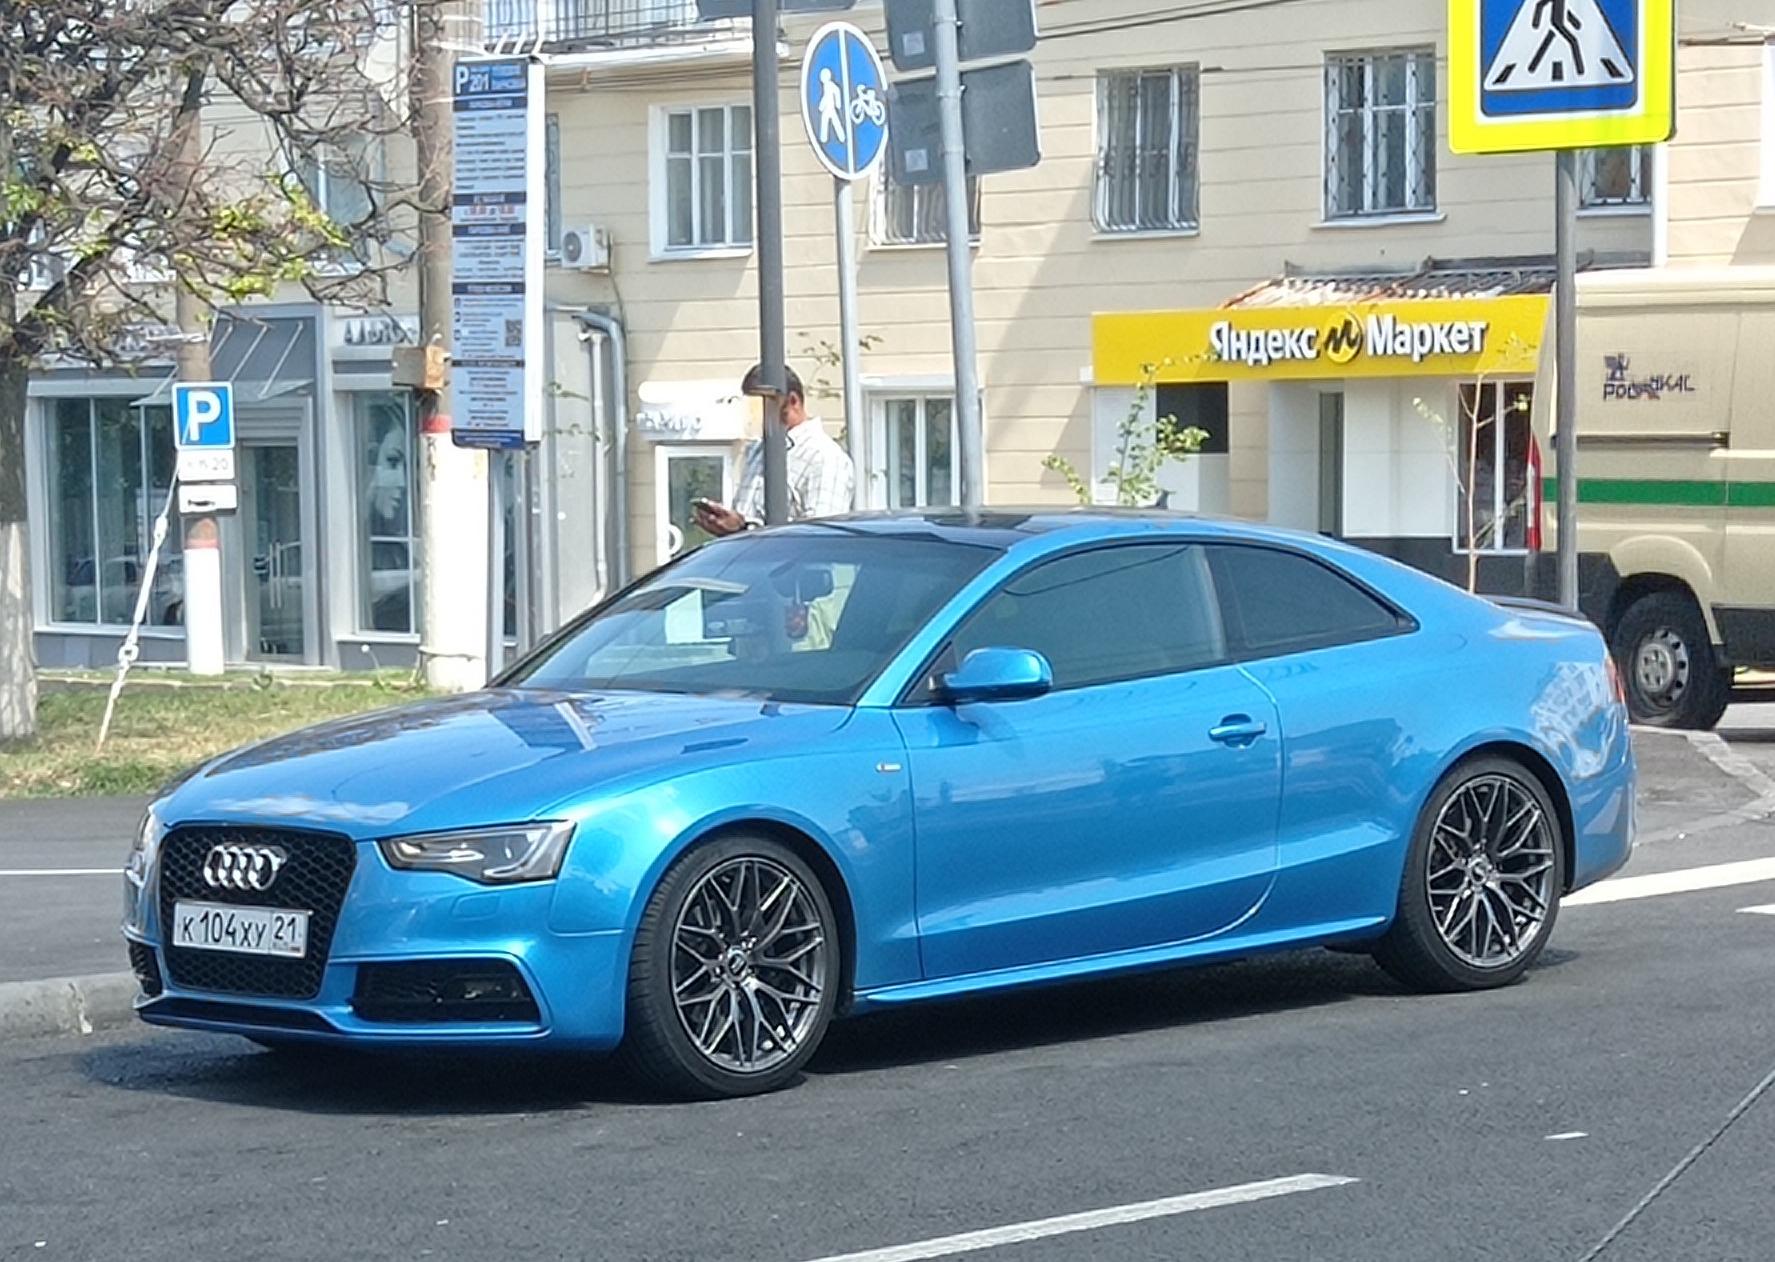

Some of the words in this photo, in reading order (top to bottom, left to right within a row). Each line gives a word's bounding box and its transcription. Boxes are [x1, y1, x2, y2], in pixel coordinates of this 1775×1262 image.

[1210, 321, 1319, 366] Яндекс
[1367, 313, 1489, 363] Маркет
[188, 391, 221, 441] P
[273, 915, 296, 942] 21
